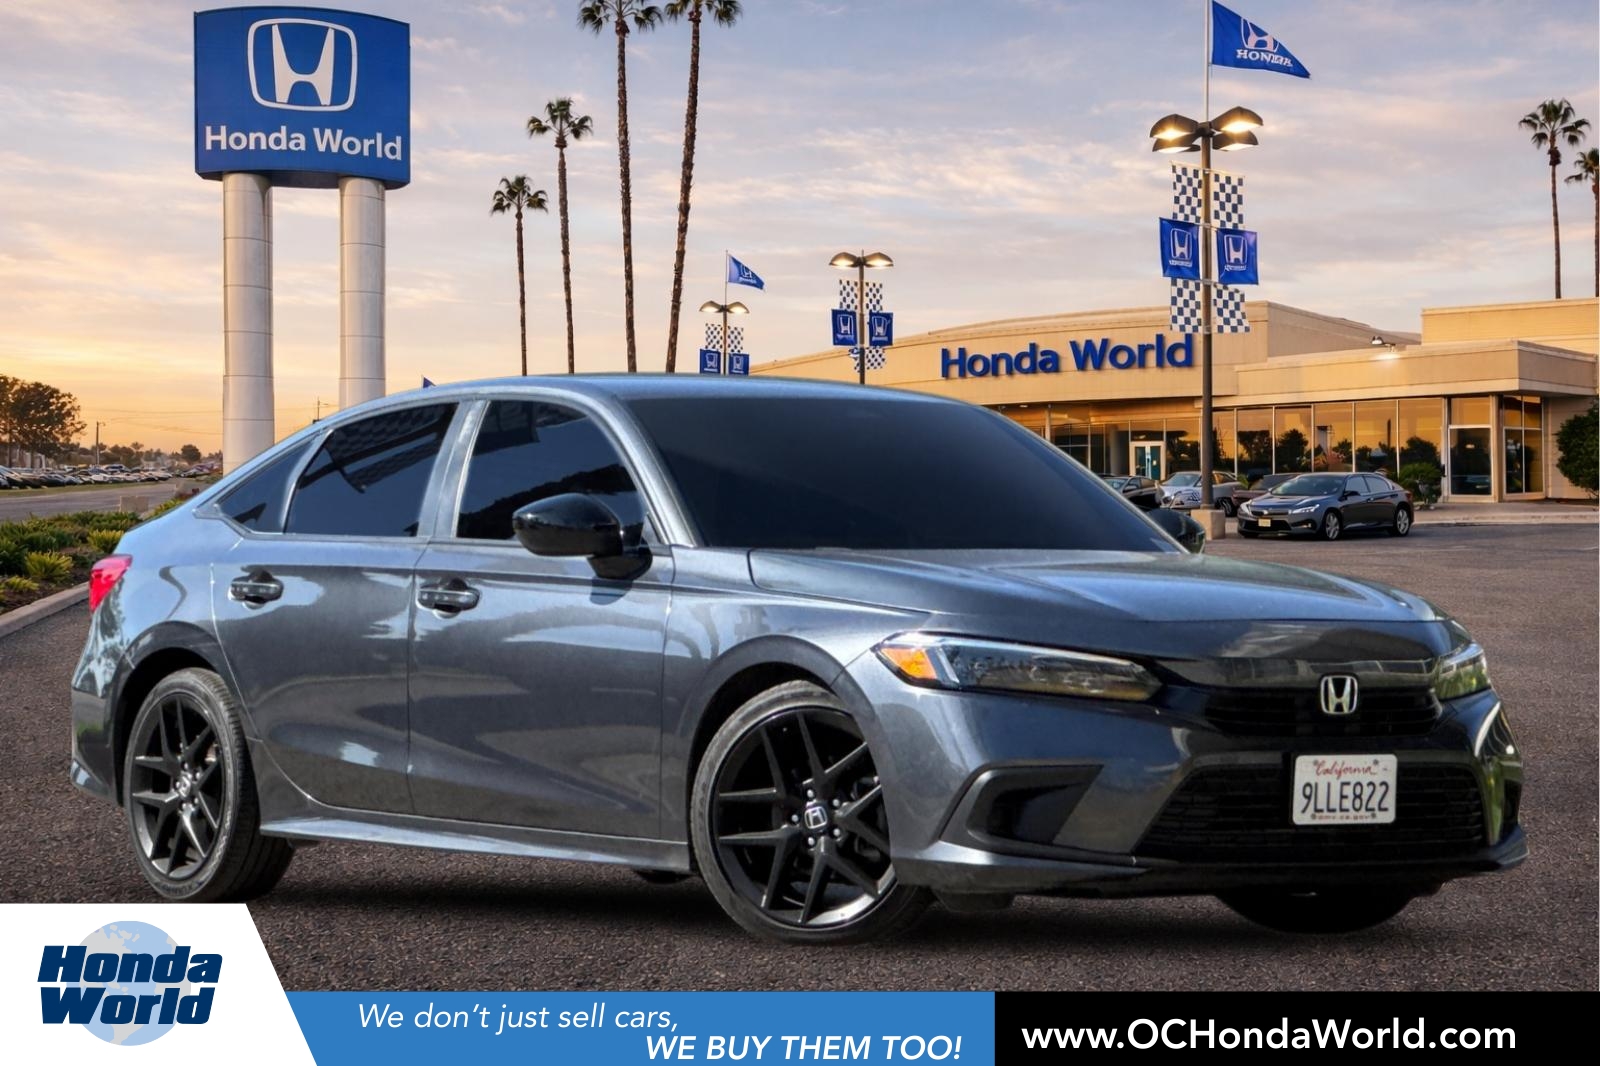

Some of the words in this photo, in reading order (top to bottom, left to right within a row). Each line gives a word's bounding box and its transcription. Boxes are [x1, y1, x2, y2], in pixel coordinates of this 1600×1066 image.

[205, 125, 306, 152] Honda
[313, 127, 402, 161] World
[941, 342, 1060, 378] Honda
[1069, 333, 1195, 371] World
[1315, 760, 1377, 780] California
[1301, 780, 1390, 813] 9LLE822
